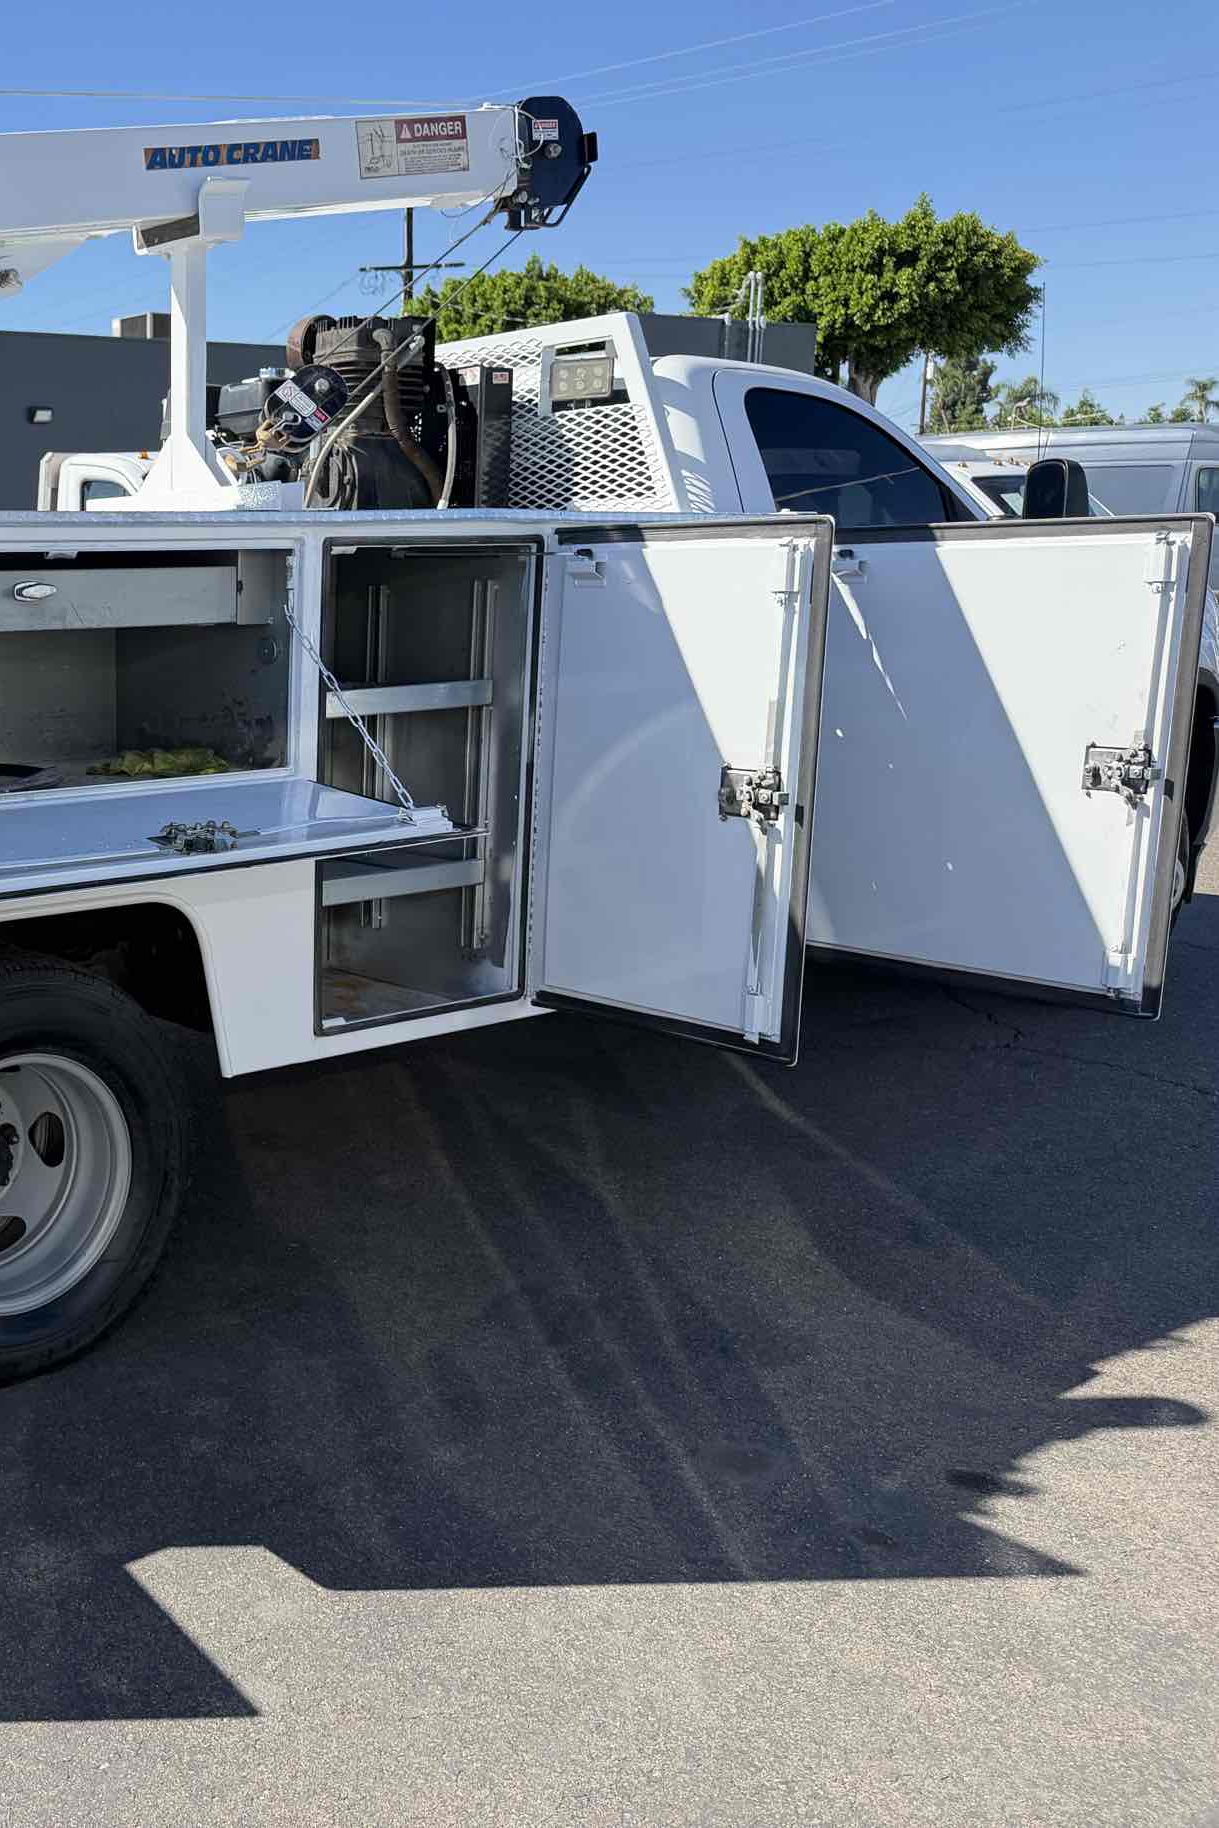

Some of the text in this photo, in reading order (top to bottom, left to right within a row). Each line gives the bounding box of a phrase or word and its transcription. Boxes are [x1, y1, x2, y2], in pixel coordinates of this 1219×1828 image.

[413, 120, 463, 138] DANGER
[145, 138, 313, 170] AUTO CRANE
